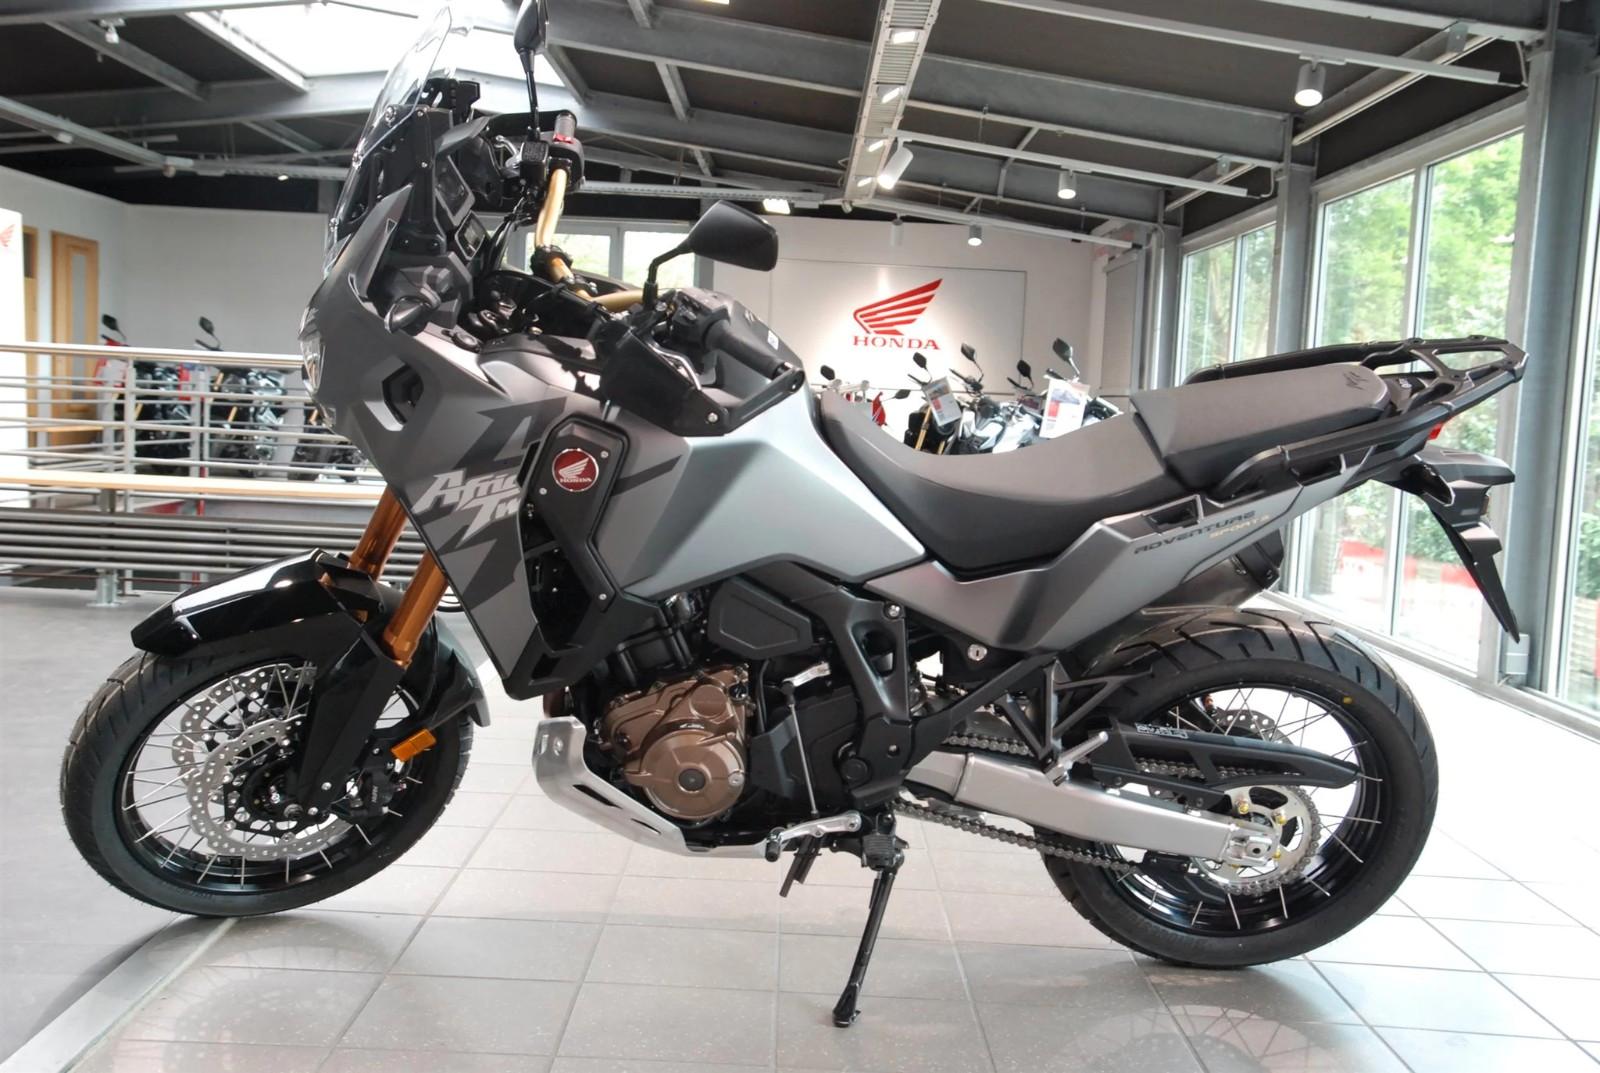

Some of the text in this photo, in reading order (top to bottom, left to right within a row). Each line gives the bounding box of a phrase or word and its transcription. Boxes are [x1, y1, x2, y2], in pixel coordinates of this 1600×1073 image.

[853, 335, 940, 350] HONDA
[411, 470, 519, 515] Afric
[1133, 509, 1257, 555] ADVENTURE
[1209, 514, 1271, 540] SPORTS
